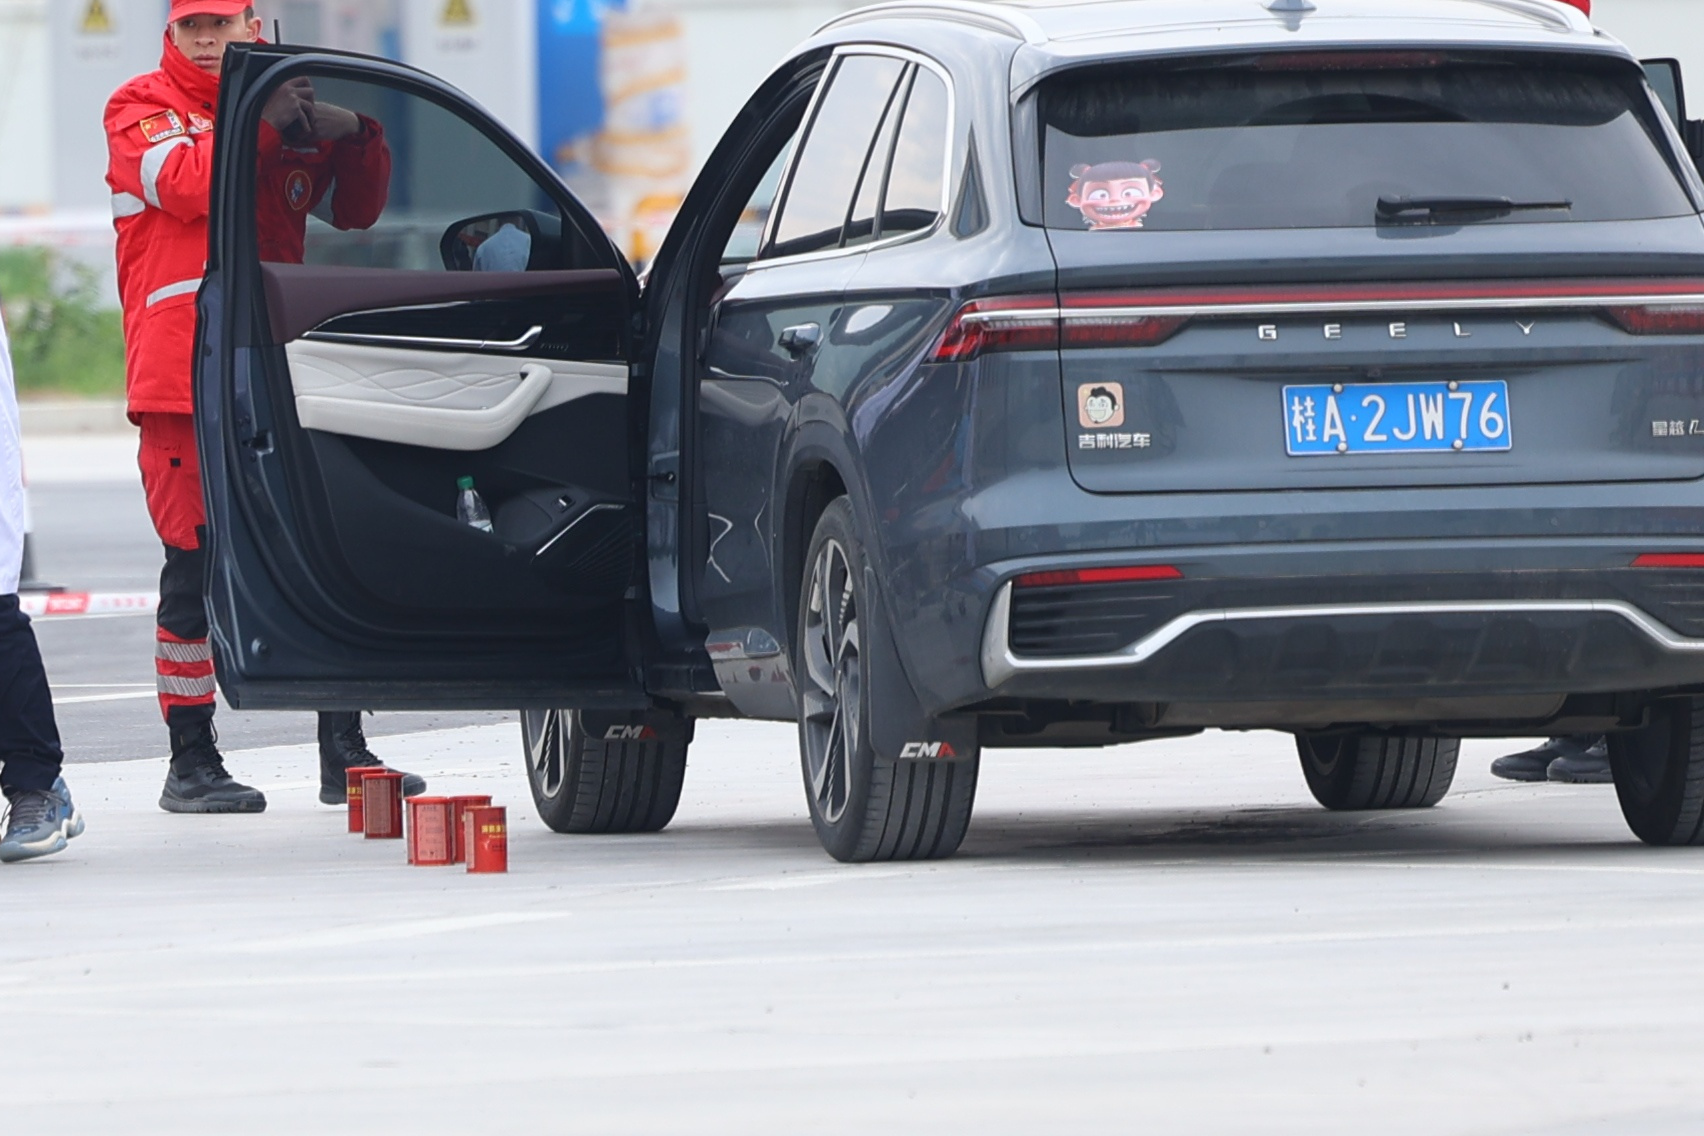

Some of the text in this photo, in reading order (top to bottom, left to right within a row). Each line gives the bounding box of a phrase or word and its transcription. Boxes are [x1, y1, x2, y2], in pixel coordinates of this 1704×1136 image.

[1257, 320, 1535, 340] GEELY
[1078, 432, 1151, 450] 吉利汽车
[604, 724, 656, 740] CMA
[899, 741, 957, 759] CMA
